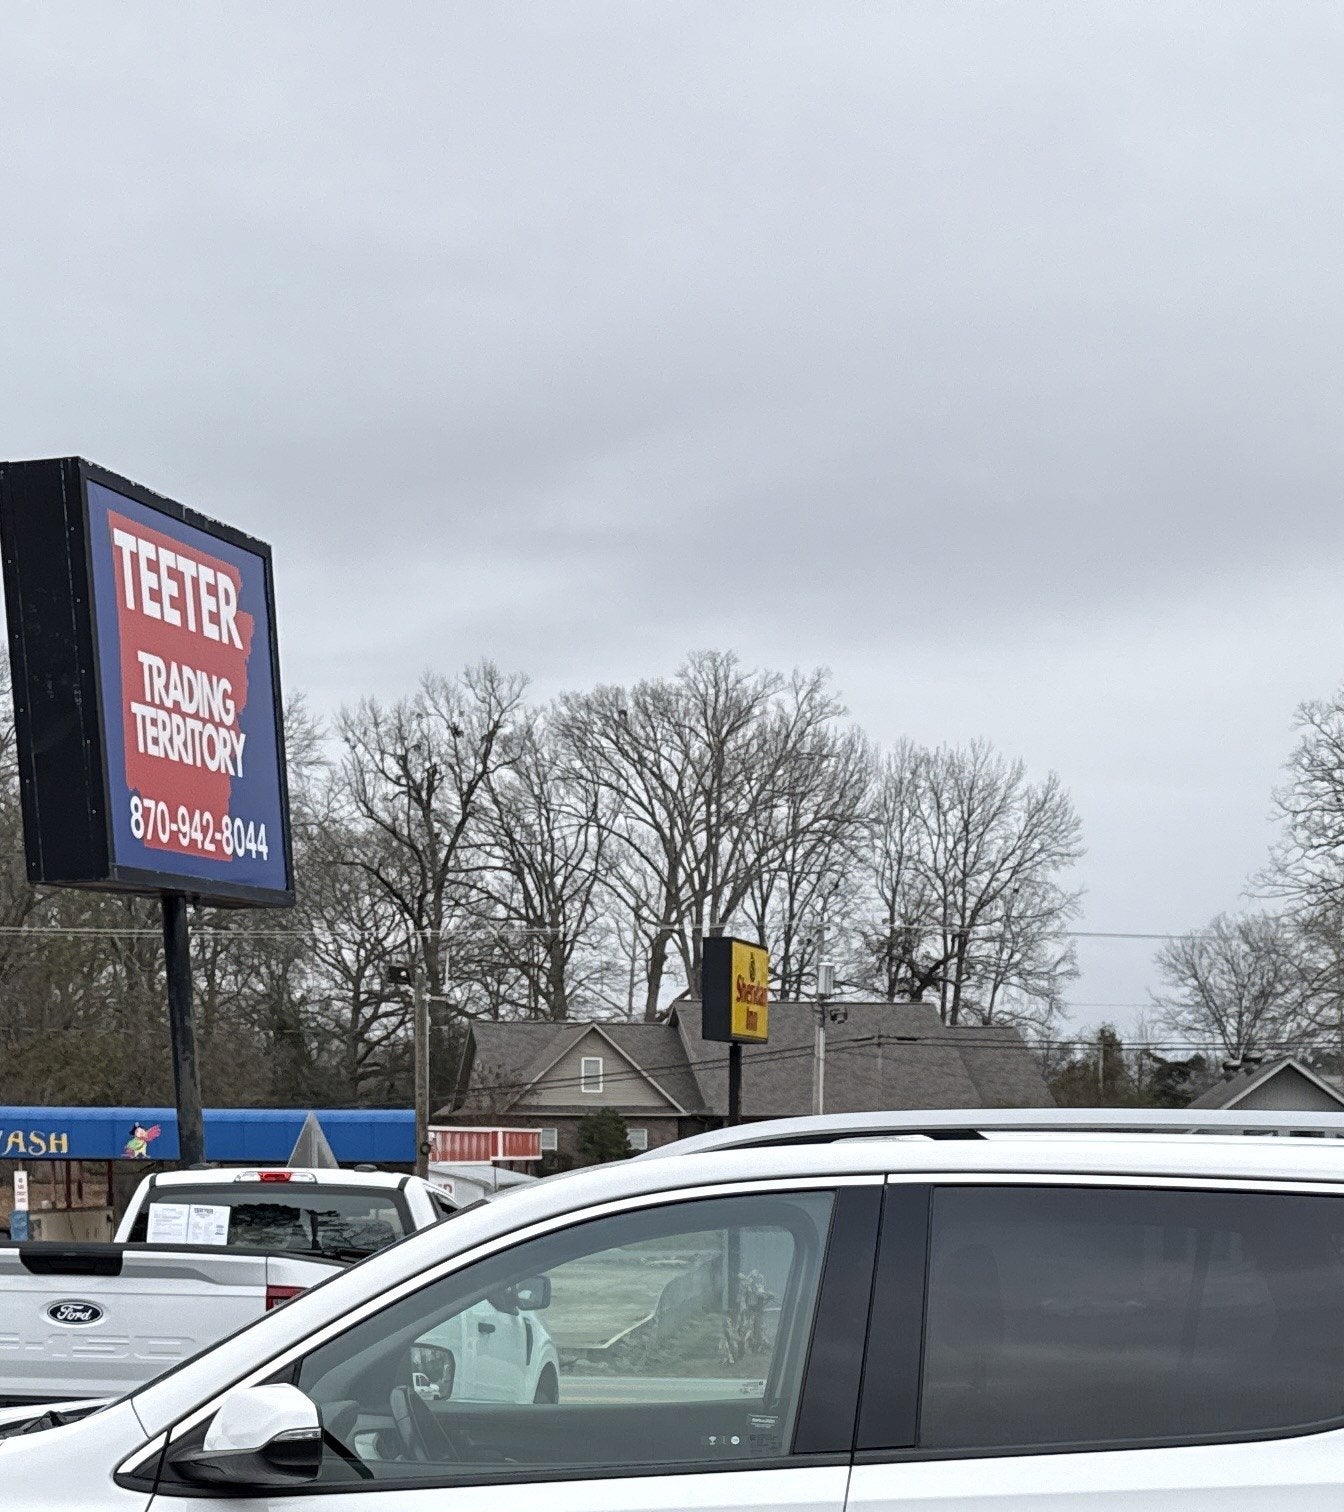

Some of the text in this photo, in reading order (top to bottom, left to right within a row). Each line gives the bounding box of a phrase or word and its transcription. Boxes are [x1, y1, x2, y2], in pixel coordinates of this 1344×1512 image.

[113, 528, 244, 650] TEETER
[137, 650, 236, 726] TRADING
[131, 702, 246, 778] TERRITORY
[130, 796, 269, 861] 870-942-8044
[57, 1304, 91, 1321] Ford
